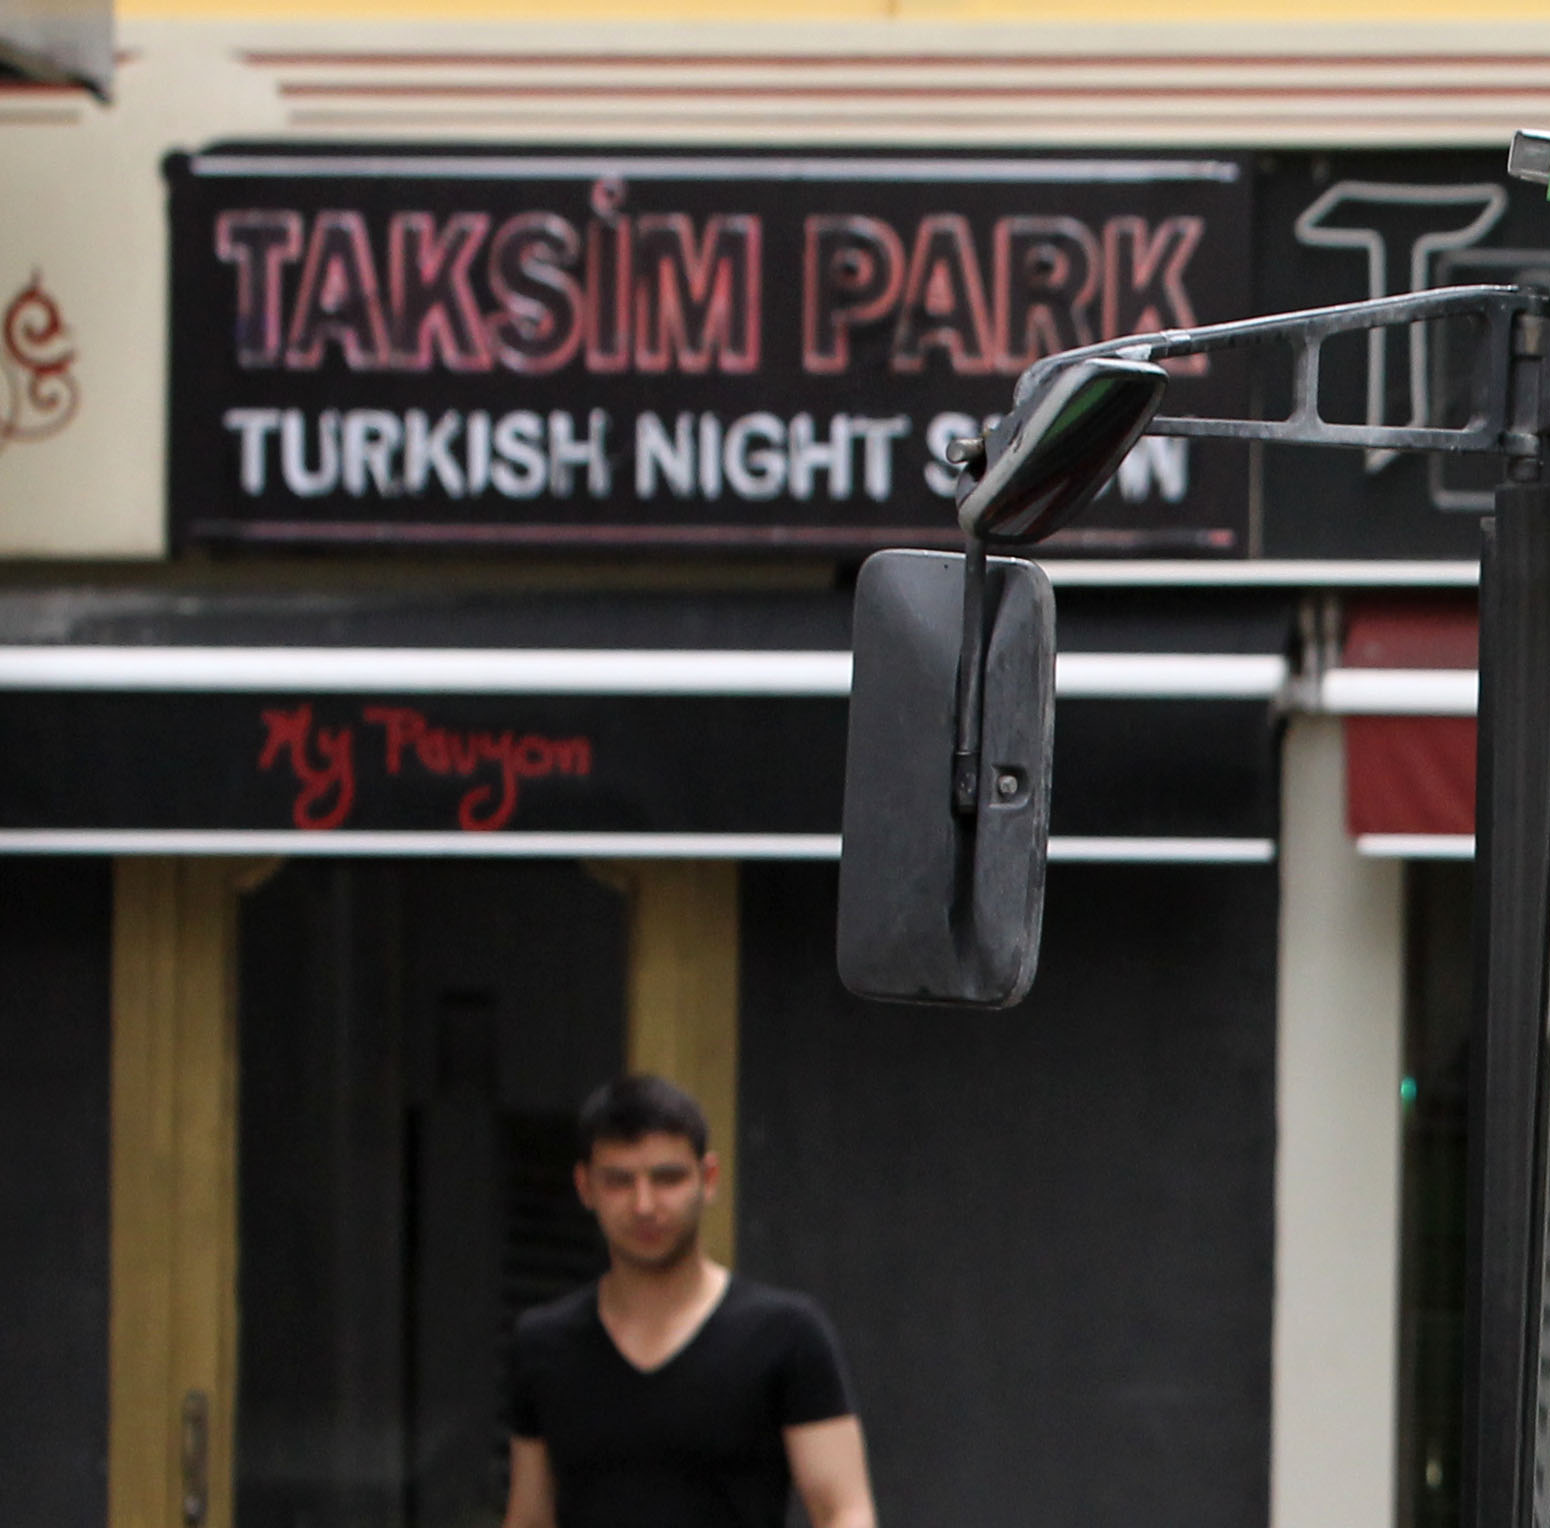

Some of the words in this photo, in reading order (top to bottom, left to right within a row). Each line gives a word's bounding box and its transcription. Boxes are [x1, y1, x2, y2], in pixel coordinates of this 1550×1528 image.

[216, 176, 762, 374] TAKSİM
[803, 213, 1210, 376] PARK
[224, 408, 609, 497] TURKISH
[636, 411, 912, 500] NIGHT
[923, 411, 1192, 504] SW
